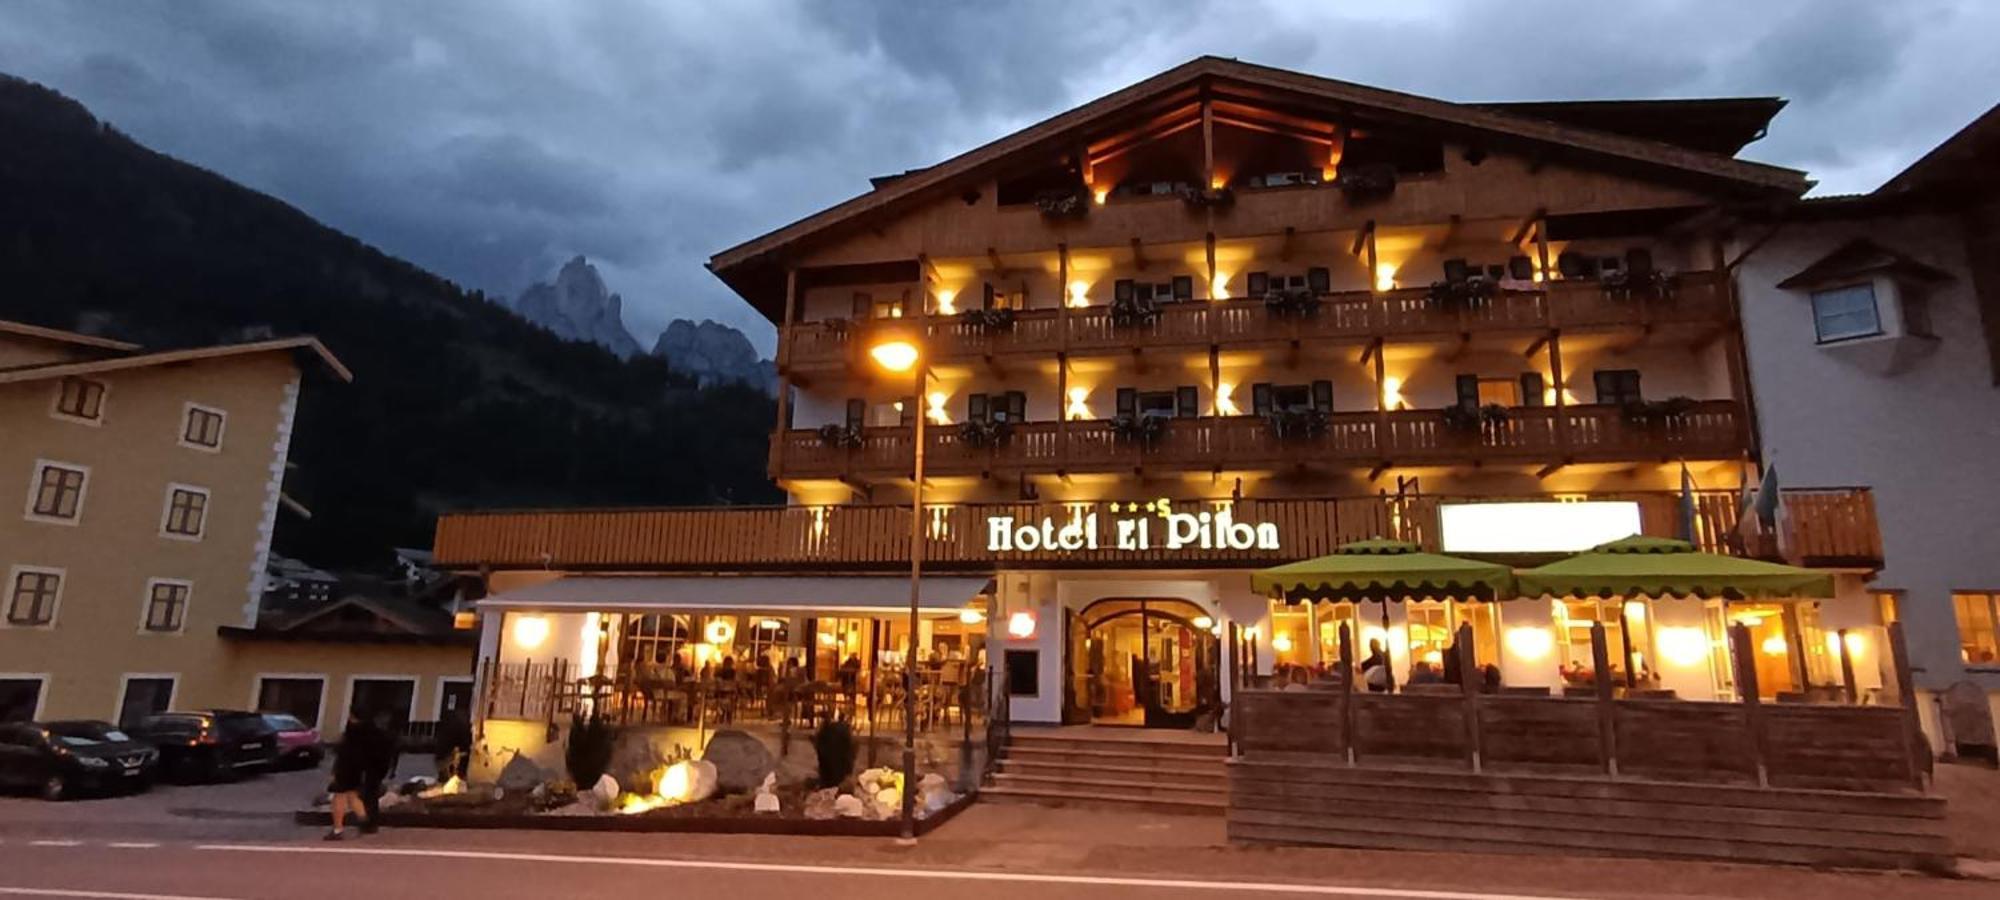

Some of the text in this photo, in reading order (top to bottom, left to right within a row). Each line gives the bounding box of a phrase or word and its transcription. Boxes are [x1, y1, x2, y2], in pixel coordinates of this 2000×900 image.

[988, 510, 1279, 550] Hotel El Pilon
